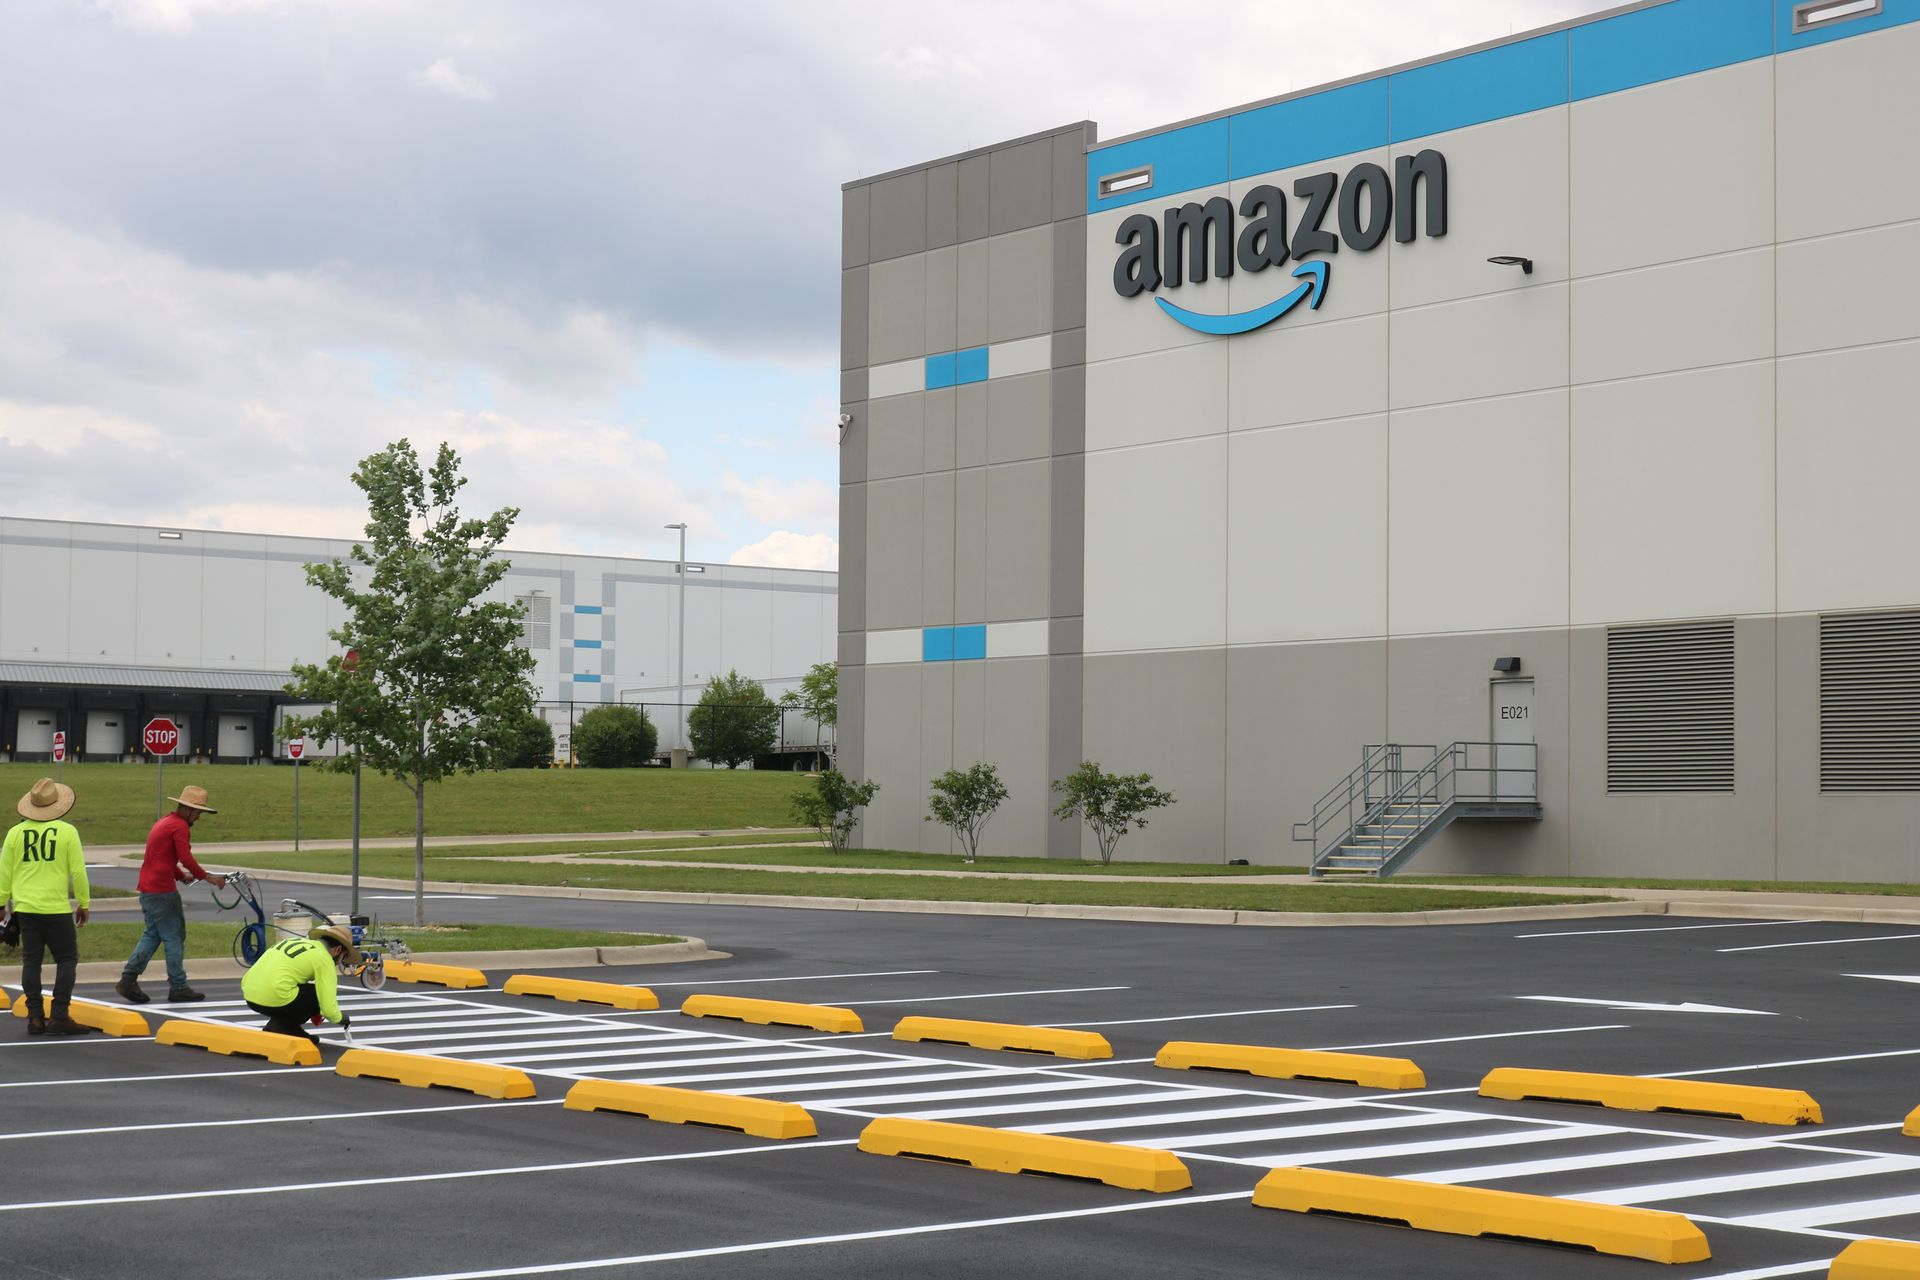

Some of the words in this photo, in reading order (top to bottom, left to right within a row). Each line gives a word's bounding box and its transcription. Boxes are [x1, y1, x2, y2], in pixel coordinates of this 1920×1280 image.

[1113, 149, 1447, 297] amazon
[1501, 706, 1529, 719] E021
[146, 730, 177, 744] STOP
[22, 827, 57, 862] RG
